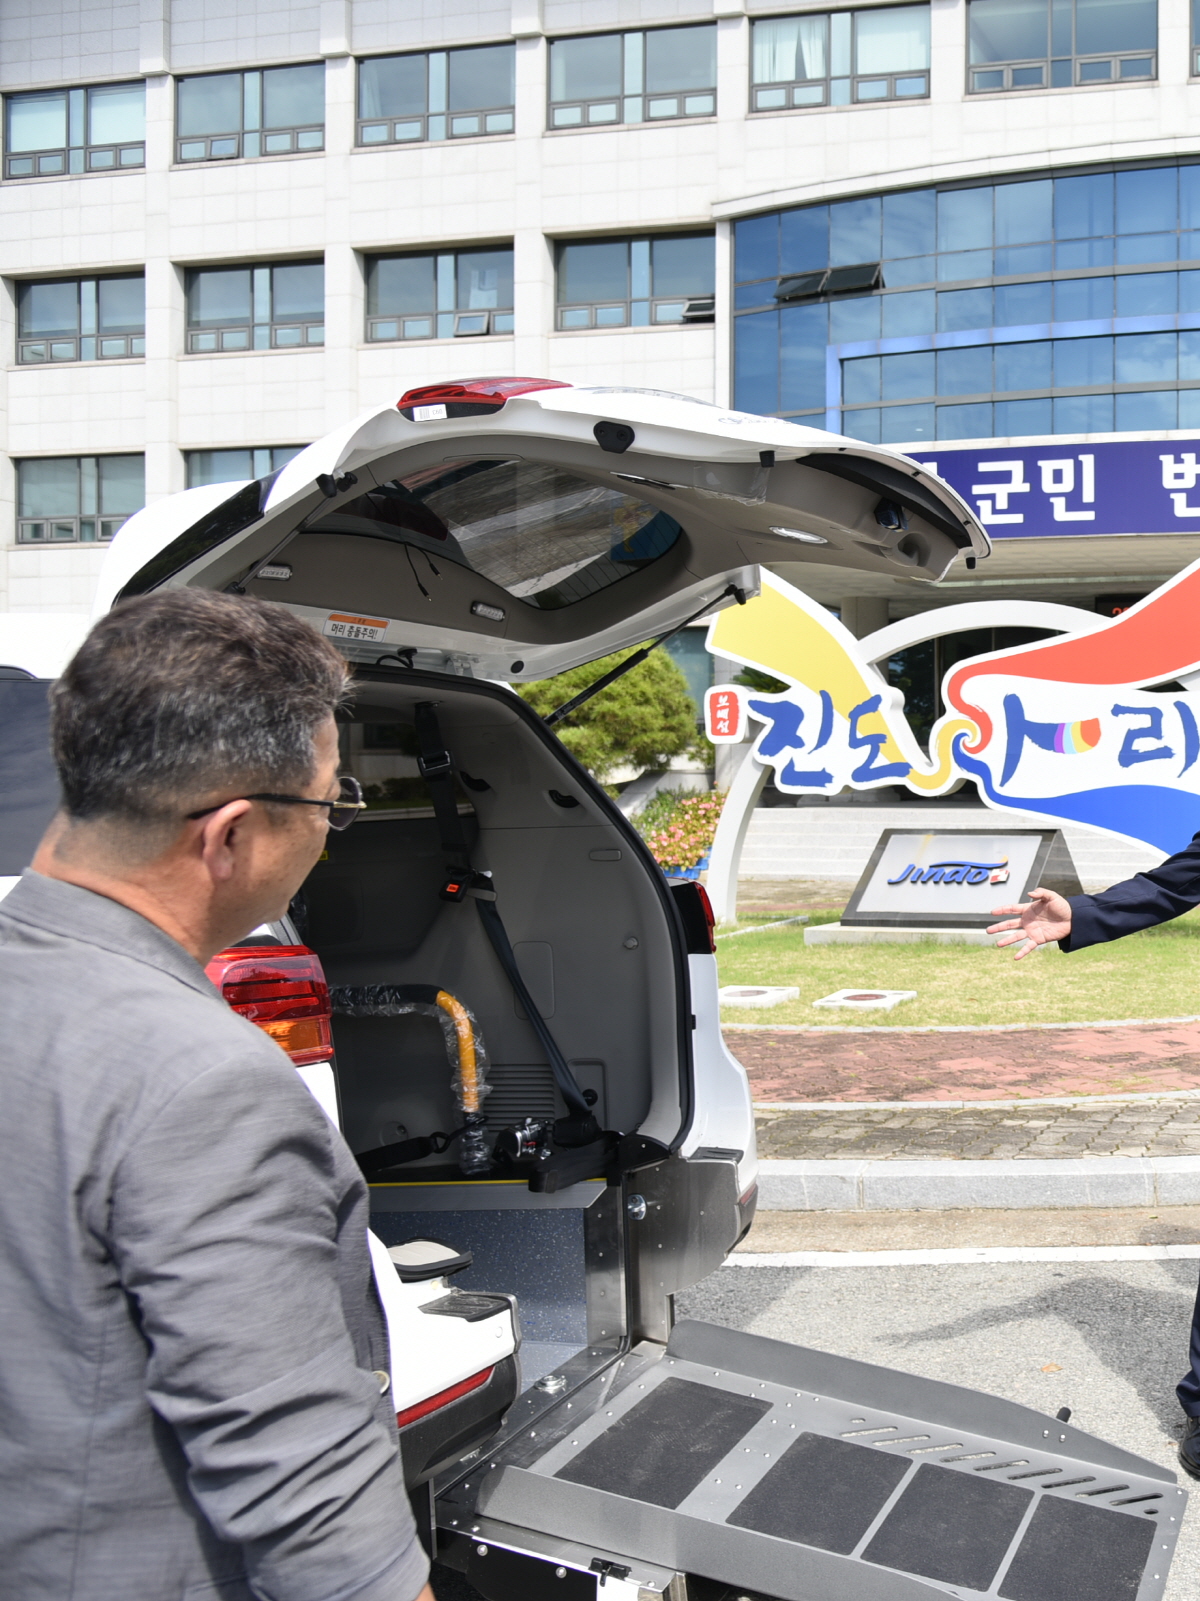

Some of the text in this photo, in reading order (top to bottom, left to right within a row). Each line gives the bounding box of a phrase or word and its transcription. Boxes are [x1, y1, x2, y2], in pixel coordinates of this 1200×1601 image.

[972, 454, 1095, 525] 군민
[331, 623, 378, 640] 머리 충돌주의!
[748, 690, 913, 788] 진도
[887, 863, 990, 885] Jindo
